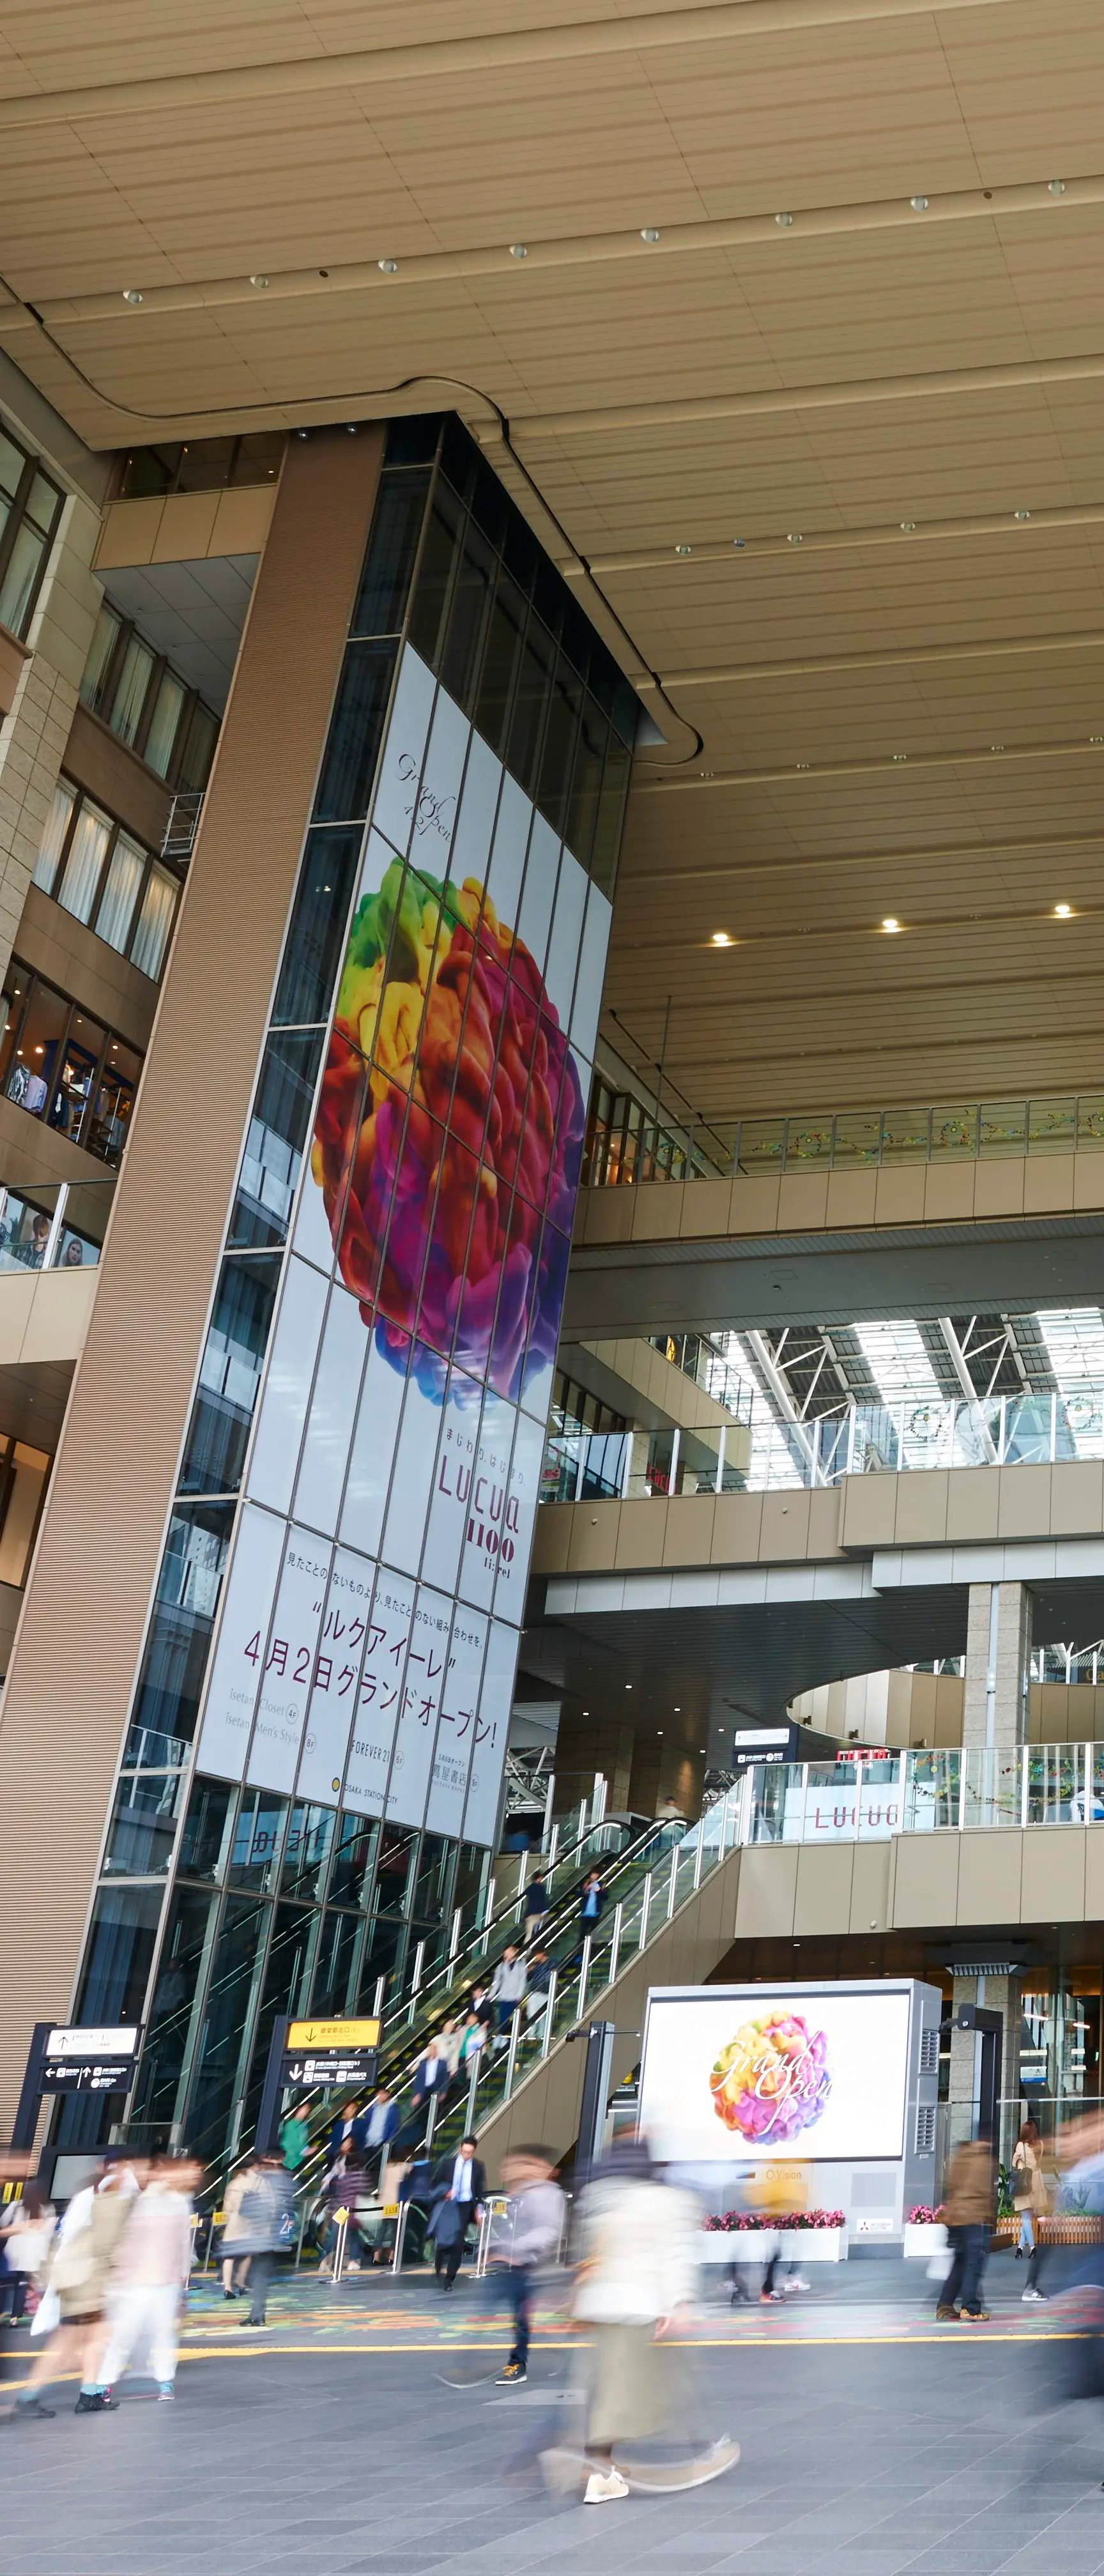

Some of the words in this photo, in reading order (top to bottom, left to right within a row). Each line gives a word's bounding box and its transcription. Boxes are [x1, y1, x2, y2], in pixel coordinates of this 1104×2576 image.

[398, 753, 456, 815] Grand
[419, 796, 451, 842] Open
[226, 1712, 250, 1729] isetan
[280, 1729, 300, 1746] Style
[229, 1688, 254, 1706] isetan
[259, 1698, 284, 1717] Closet
[710, 2030, 824, 2092] Grand
[755, 2066, 832, 2136] Open
